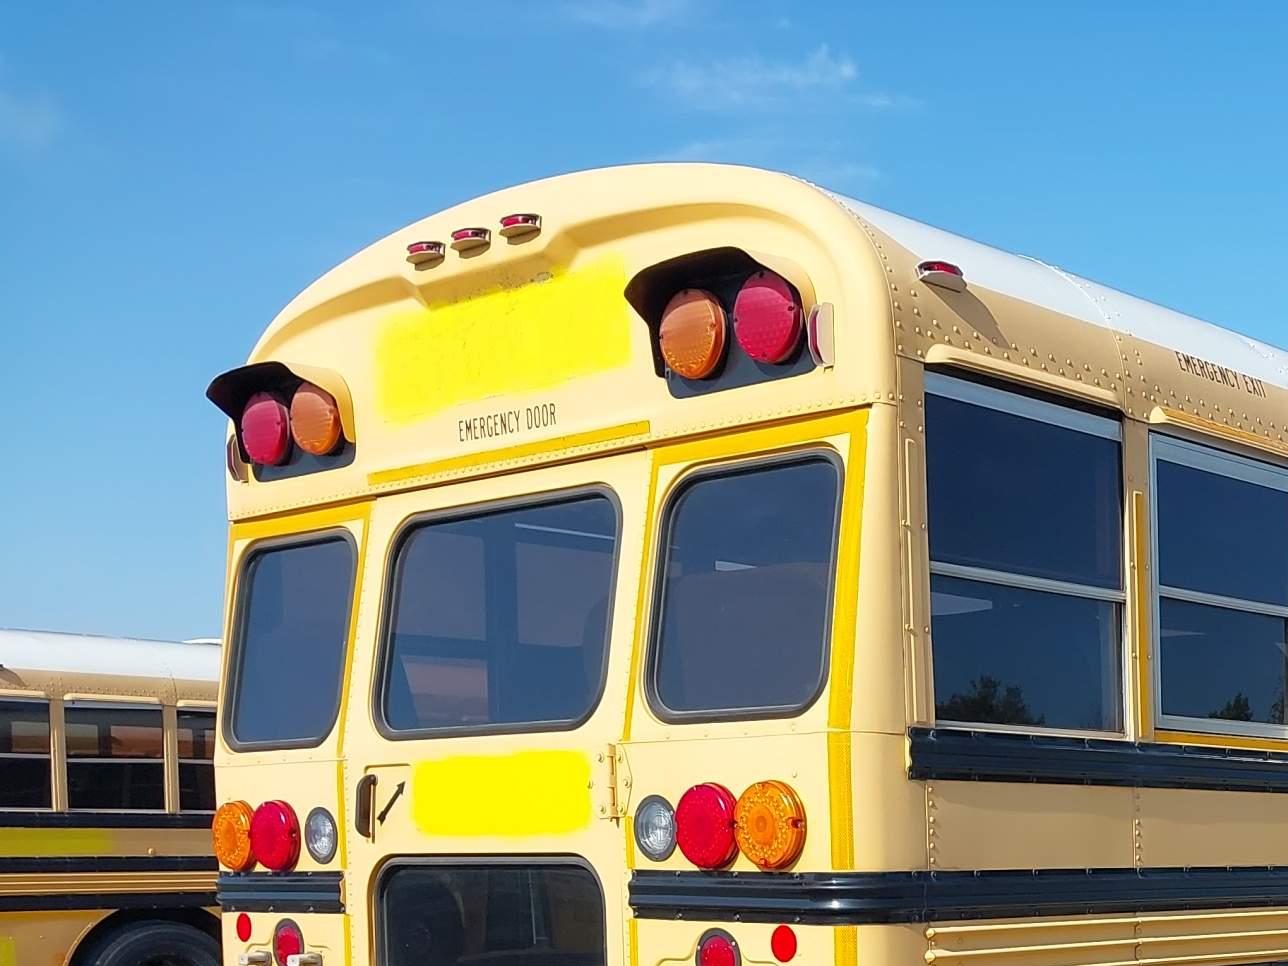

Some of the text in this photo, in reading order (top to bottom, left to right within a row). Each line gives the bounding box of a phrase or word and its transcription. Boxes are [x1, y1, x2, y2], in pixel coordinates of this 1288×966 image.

[1175, 351, 1266, 398] EMERGENCY EXIT
[458, 402, 557, 441] EMERGENCY DOOR
